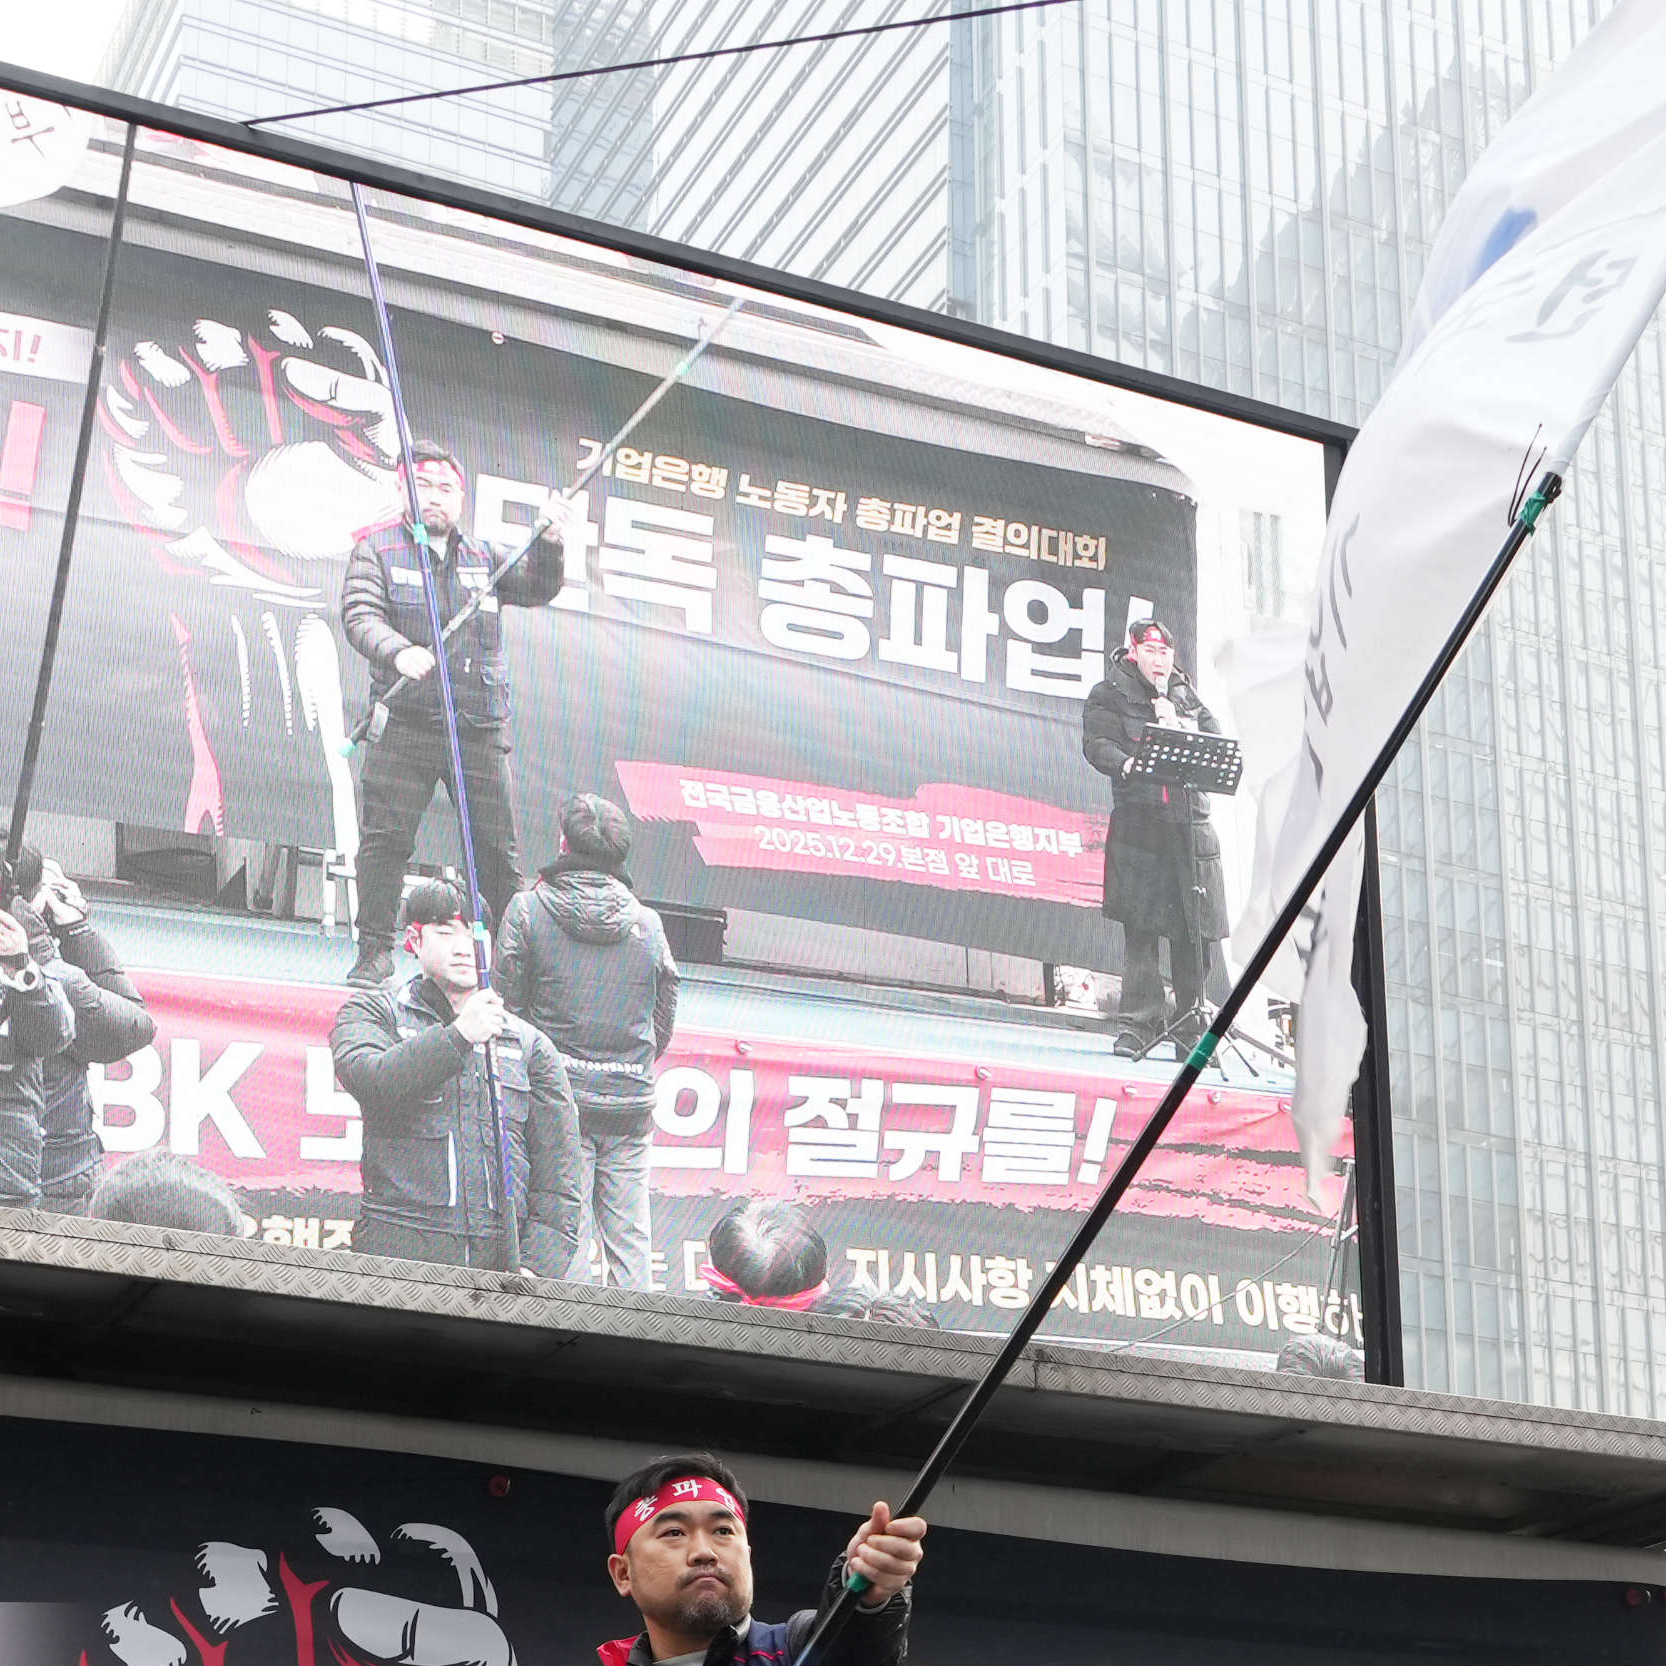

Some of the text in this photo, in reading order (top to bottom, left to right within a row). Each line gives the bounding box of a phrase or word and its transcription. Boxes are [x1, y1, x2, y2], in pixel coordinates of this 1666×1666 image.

[736, 473, 848, 522] 노동자
[855, 496, 962, 545] 총파업
[971, 517, 1107, 571] 결의대회
[88, 1038, 267, 1160] BK
[785, 1075, 1119, 1185] 절규를!
